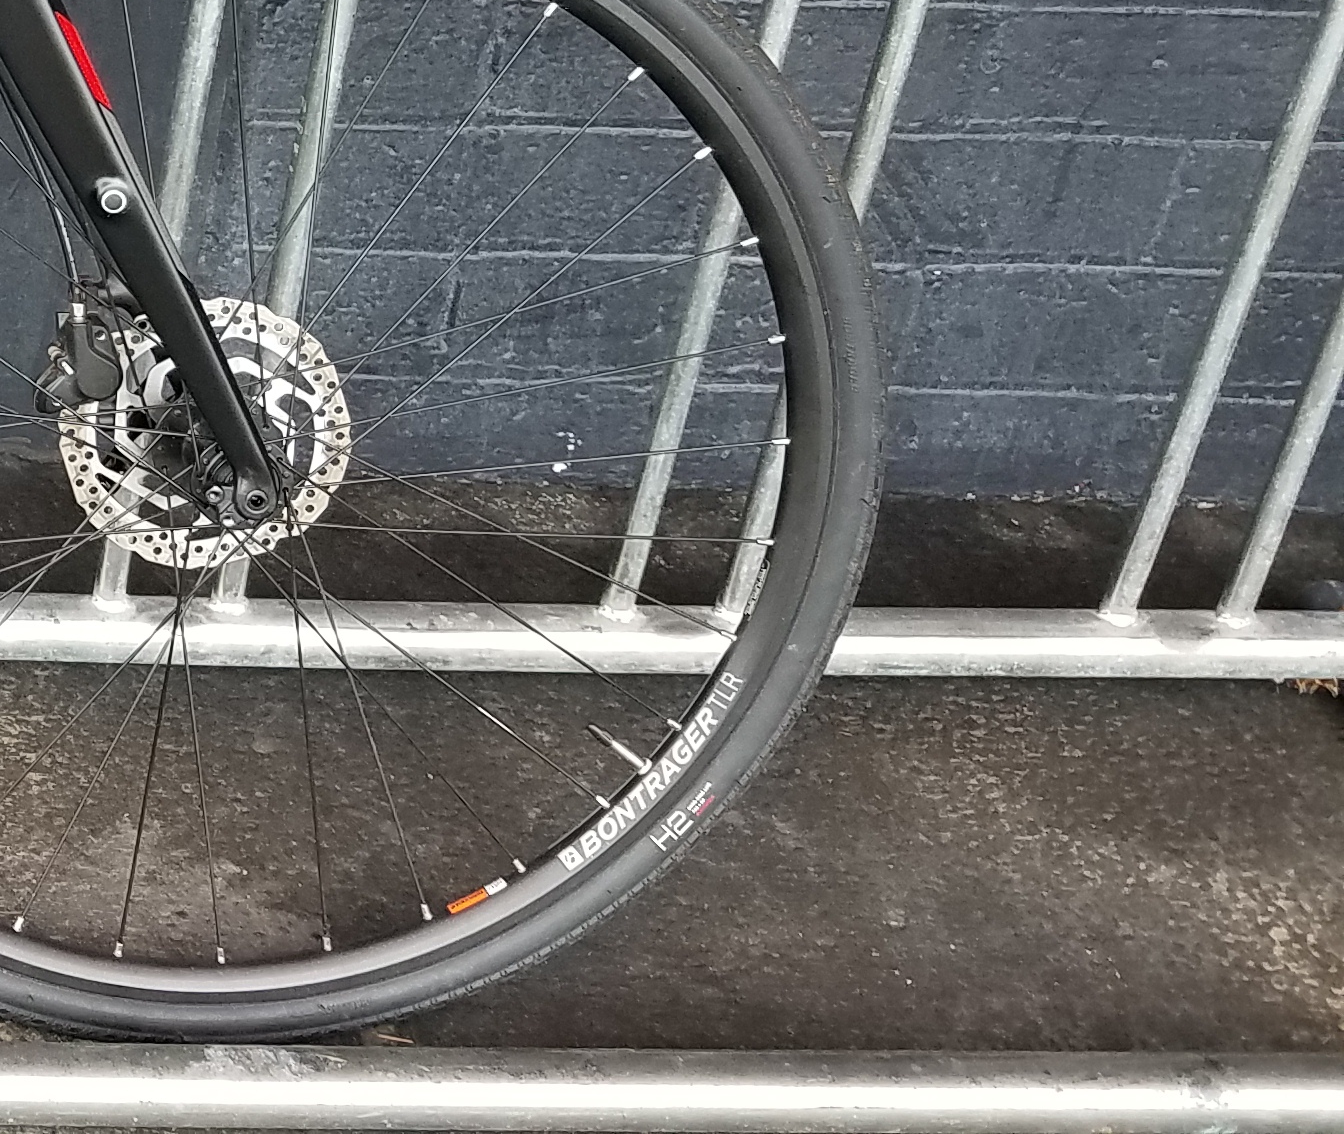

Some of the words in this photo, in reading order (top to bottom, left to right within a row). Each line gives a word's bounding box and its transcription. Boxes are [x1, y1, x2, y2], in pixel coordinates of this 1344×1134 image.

[579, 708, 721, 859] BONTRAGER
[716, 671, 744, 712] TLR
[648, 810, 695, 852] H2
